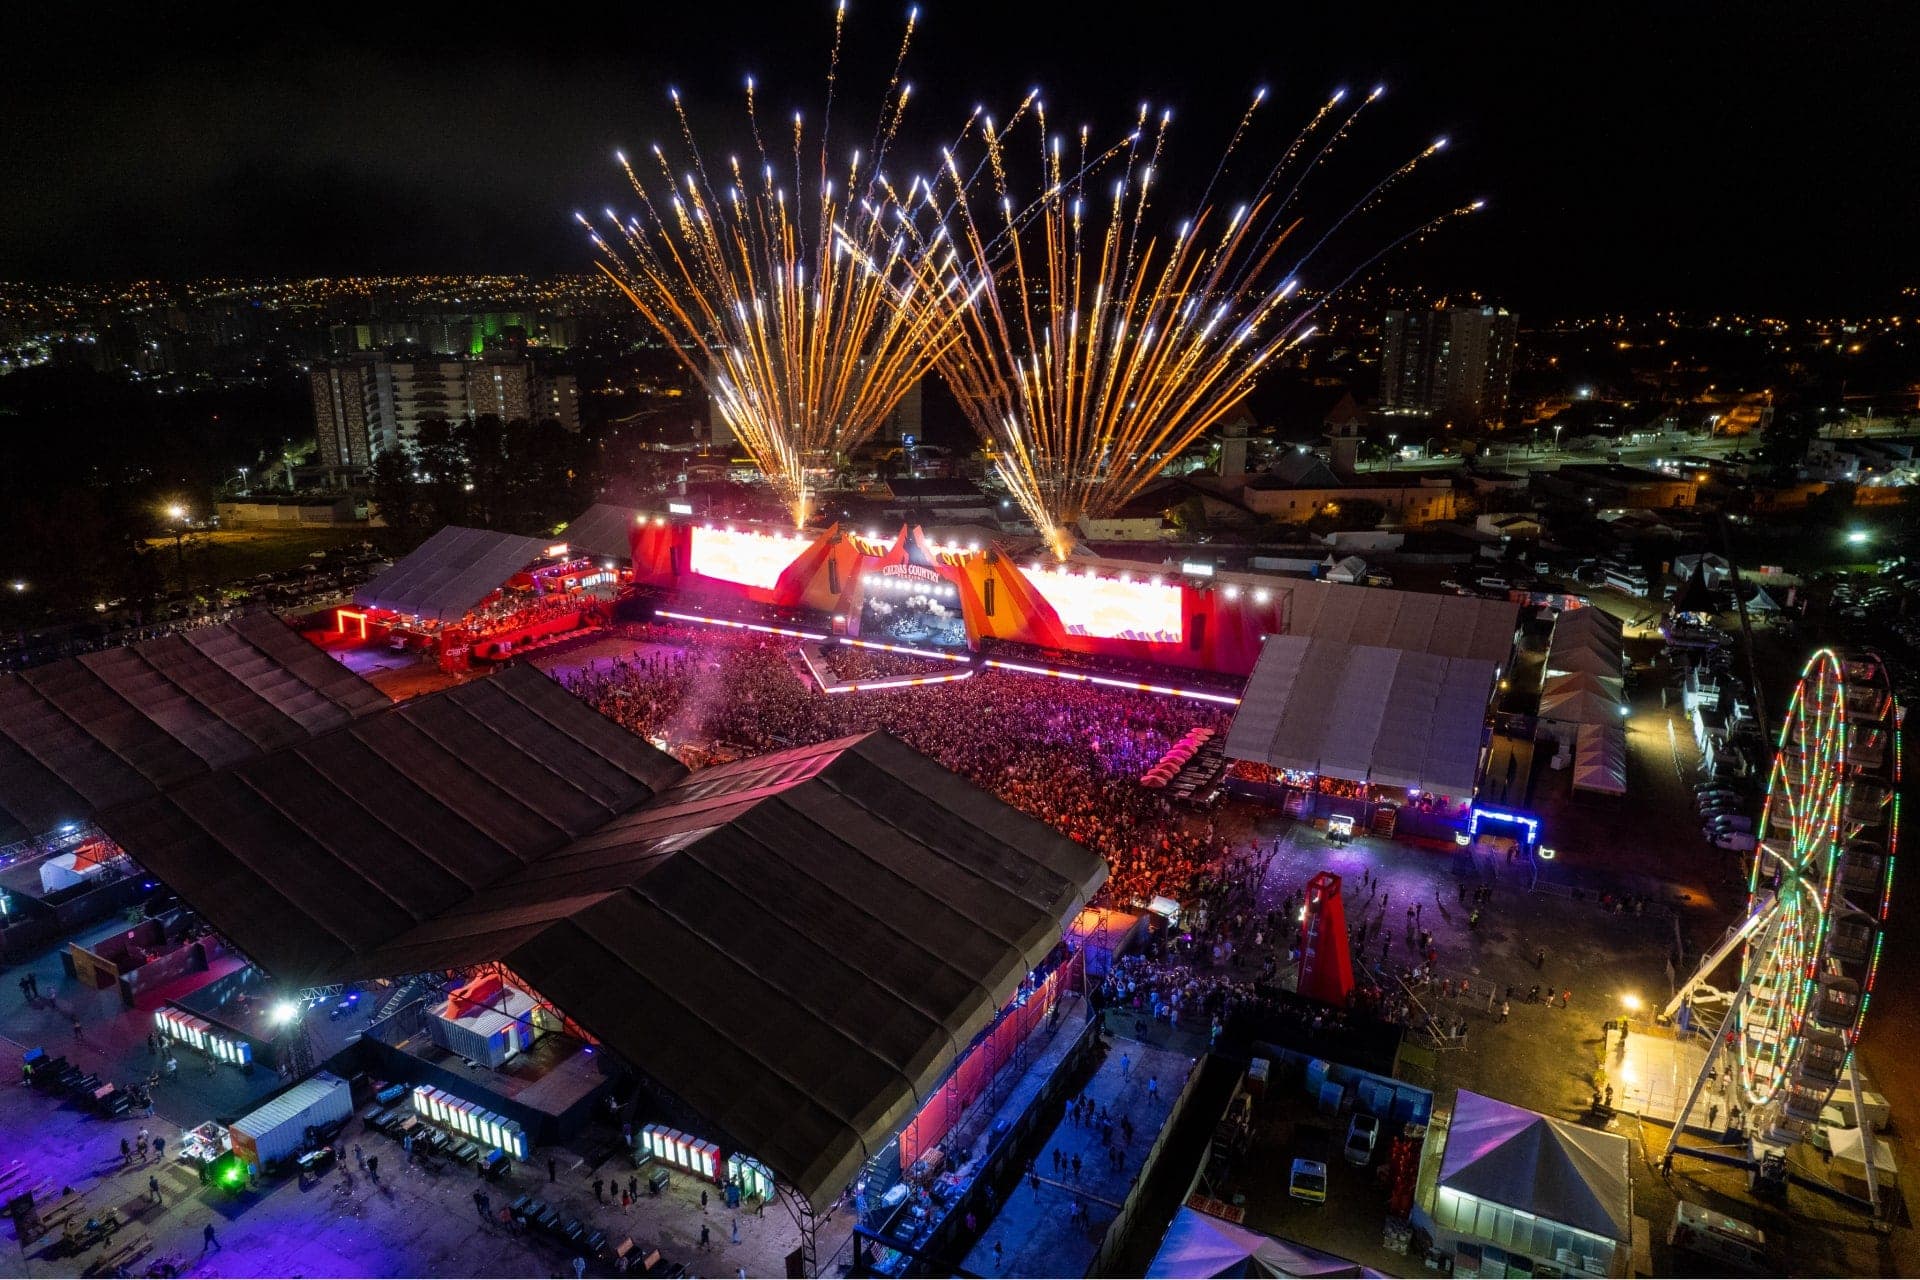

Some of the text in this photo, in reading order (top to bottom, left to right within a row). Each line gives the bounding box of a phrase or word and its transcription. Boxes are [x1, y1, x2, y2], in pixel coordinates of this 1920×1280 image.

[883, 564, 939, 583] CALDAS COUNTRY
[446, 646, 468, 656] Claro
